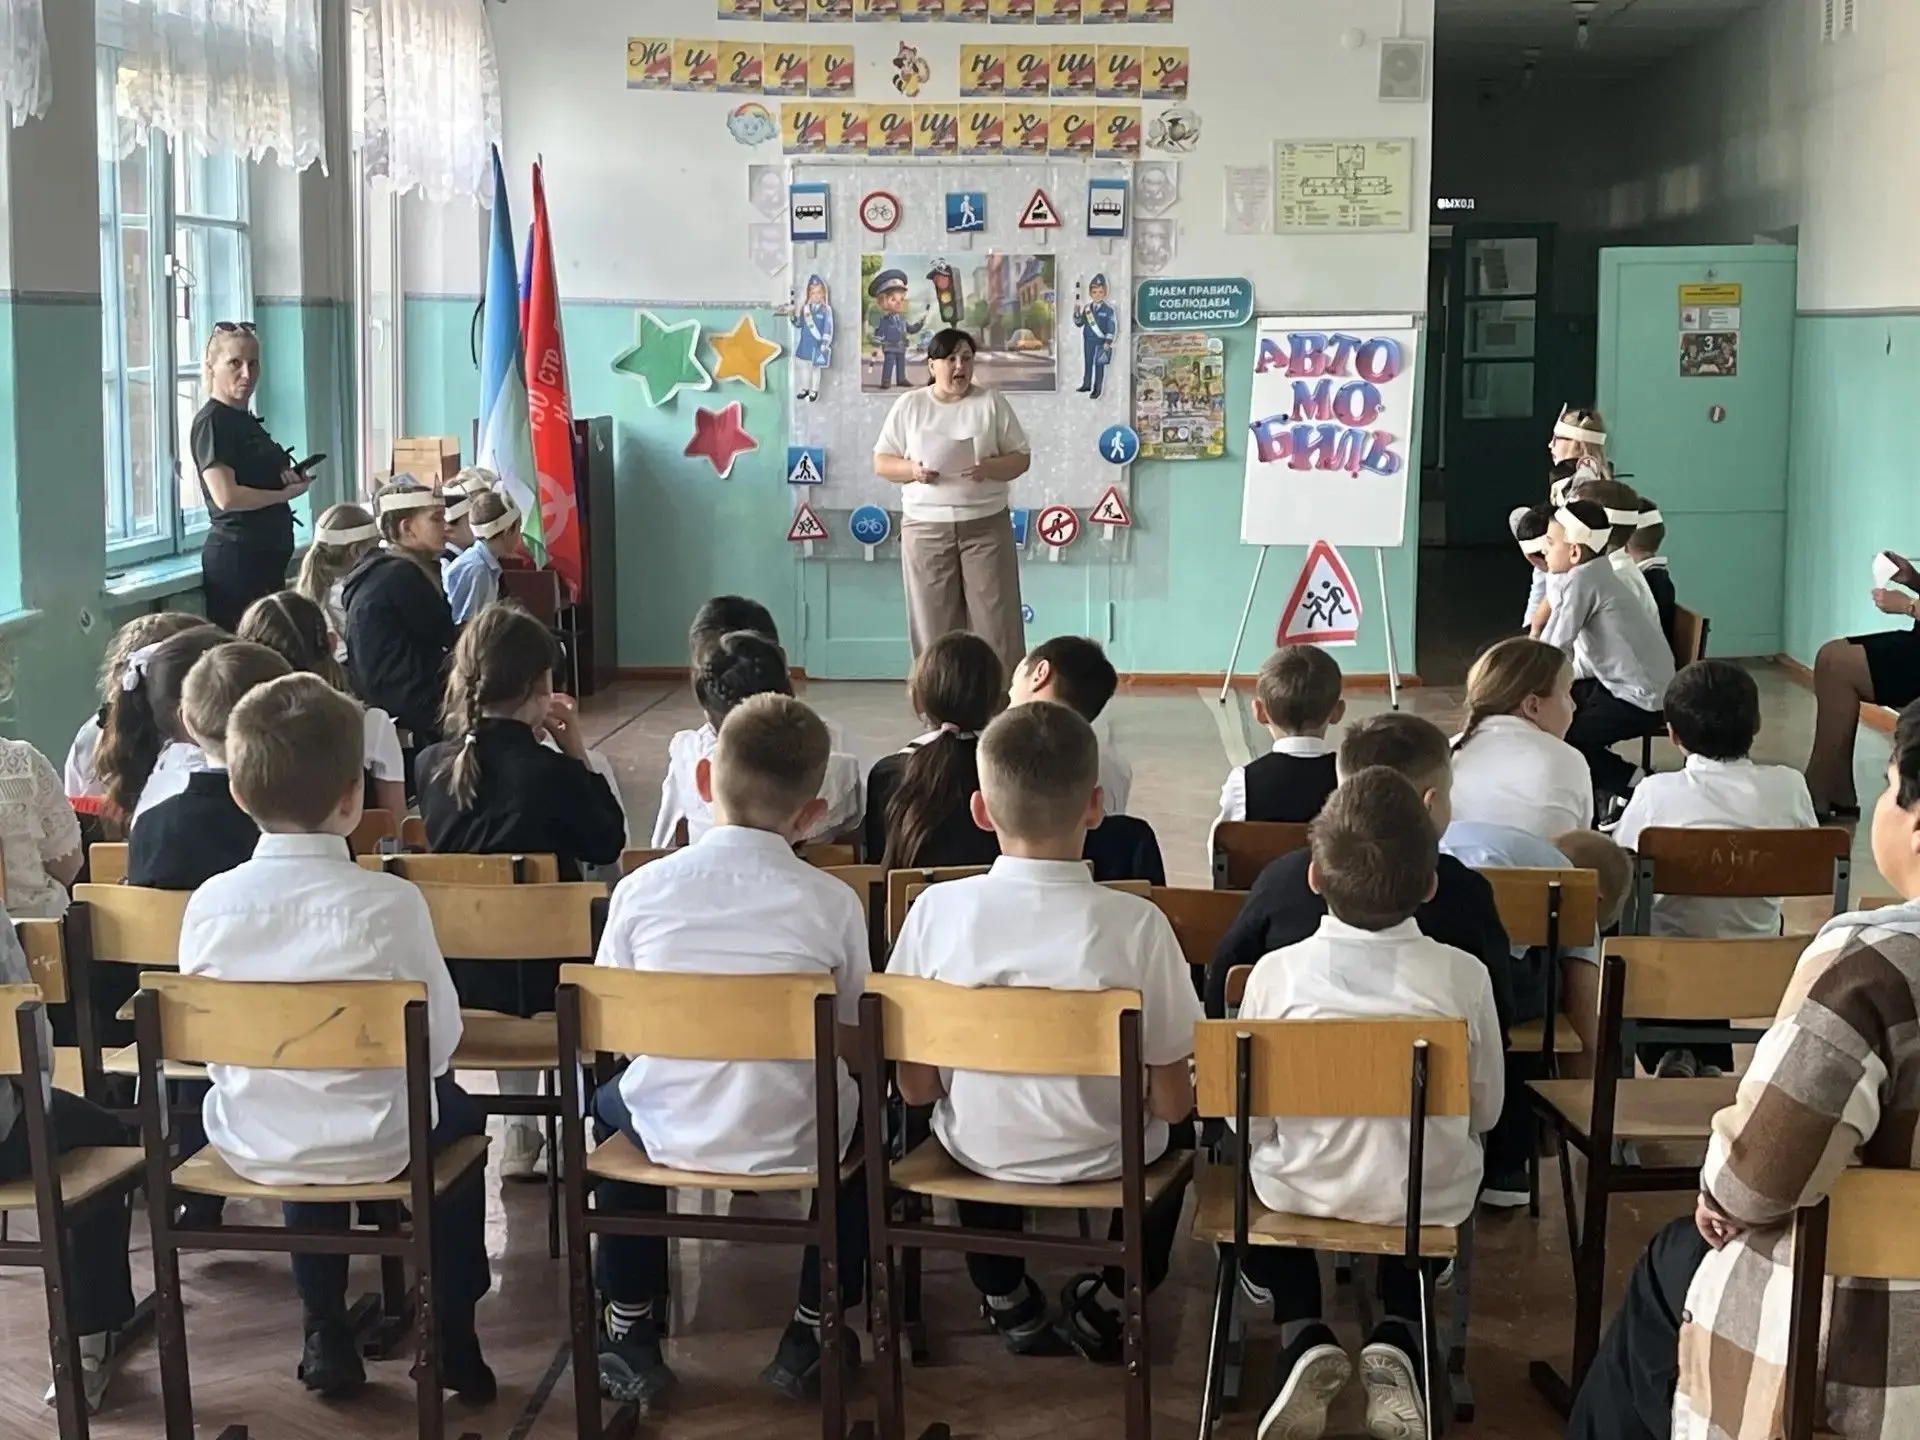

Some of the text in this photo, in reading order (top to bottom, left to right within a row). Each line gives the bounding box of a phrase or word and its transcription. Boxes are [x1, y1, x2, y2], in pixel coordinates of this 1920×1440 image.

[628, 41, 1181, 82] Жизнь наших
[793, 112, 1133, 144] учащихся
[1148, 285, 1242, 296] ЗНАЕМ ПРАВИЛА,
[1159, 298, 1231, 309] СОБЛЮДАЕМ
[1149, 309, 1240, 321] БЕЗОПАСНОСТЬ!
[1255, 332, 1400, 384] АВТО
[1290, 379, 1383, 427] МО
[1249, 414, 1400, 477] БИЛЬ
